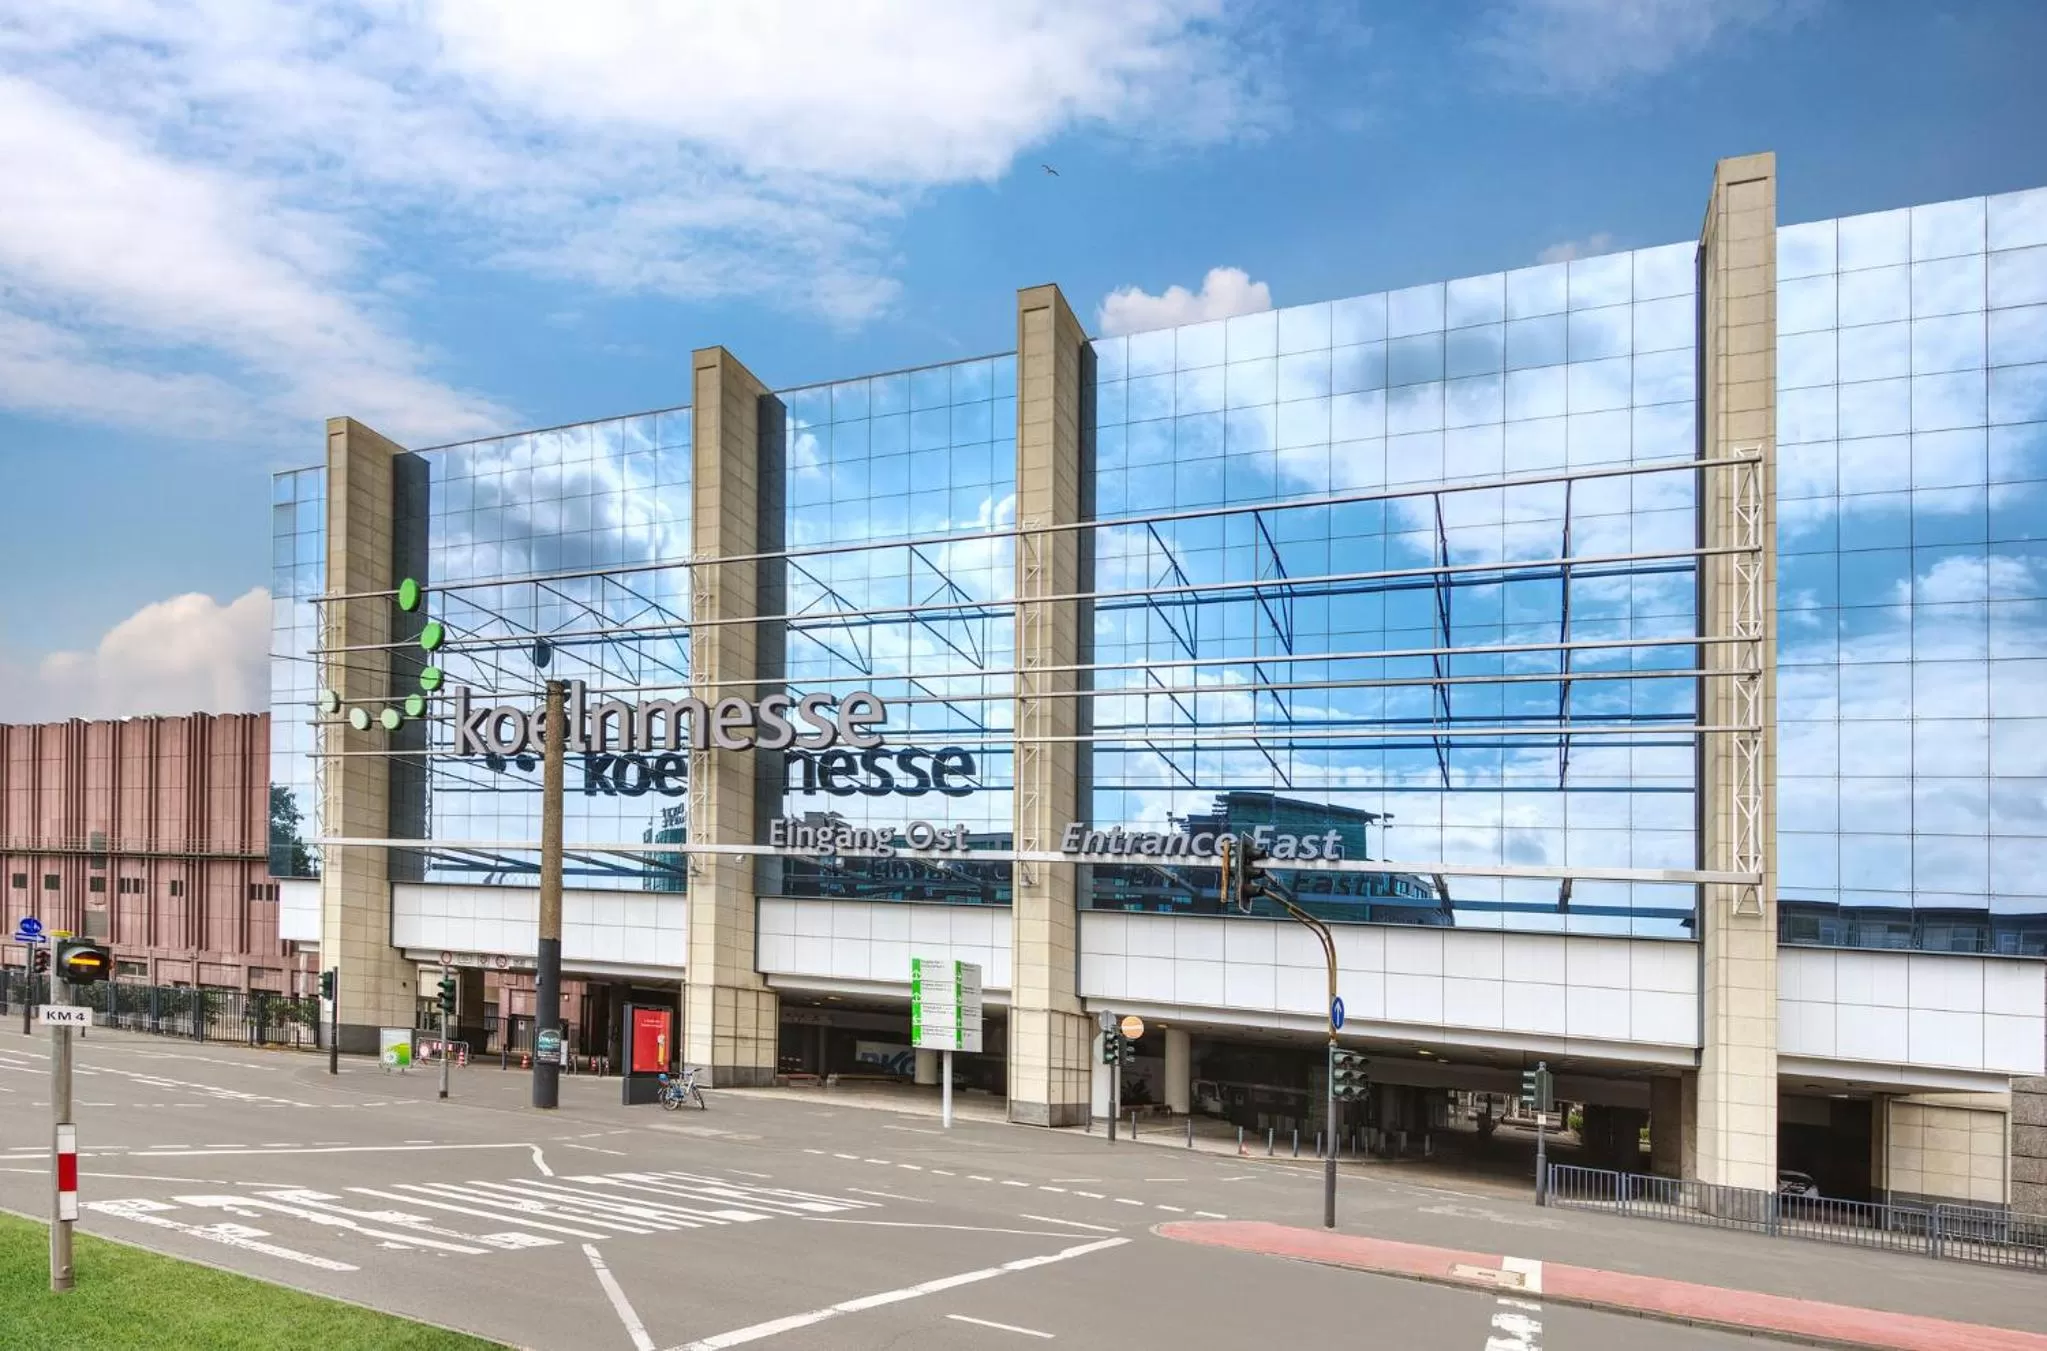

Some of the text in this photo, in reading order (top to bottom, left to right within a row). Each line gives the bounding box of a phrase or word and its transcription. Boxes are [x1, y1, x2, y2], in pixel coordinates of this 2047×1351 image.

[769, 818, 969, 858] Eingang Ost
[1060, 822, 1342, 860] Entrance East
[46, 1010, 86, 1021] KM 4
